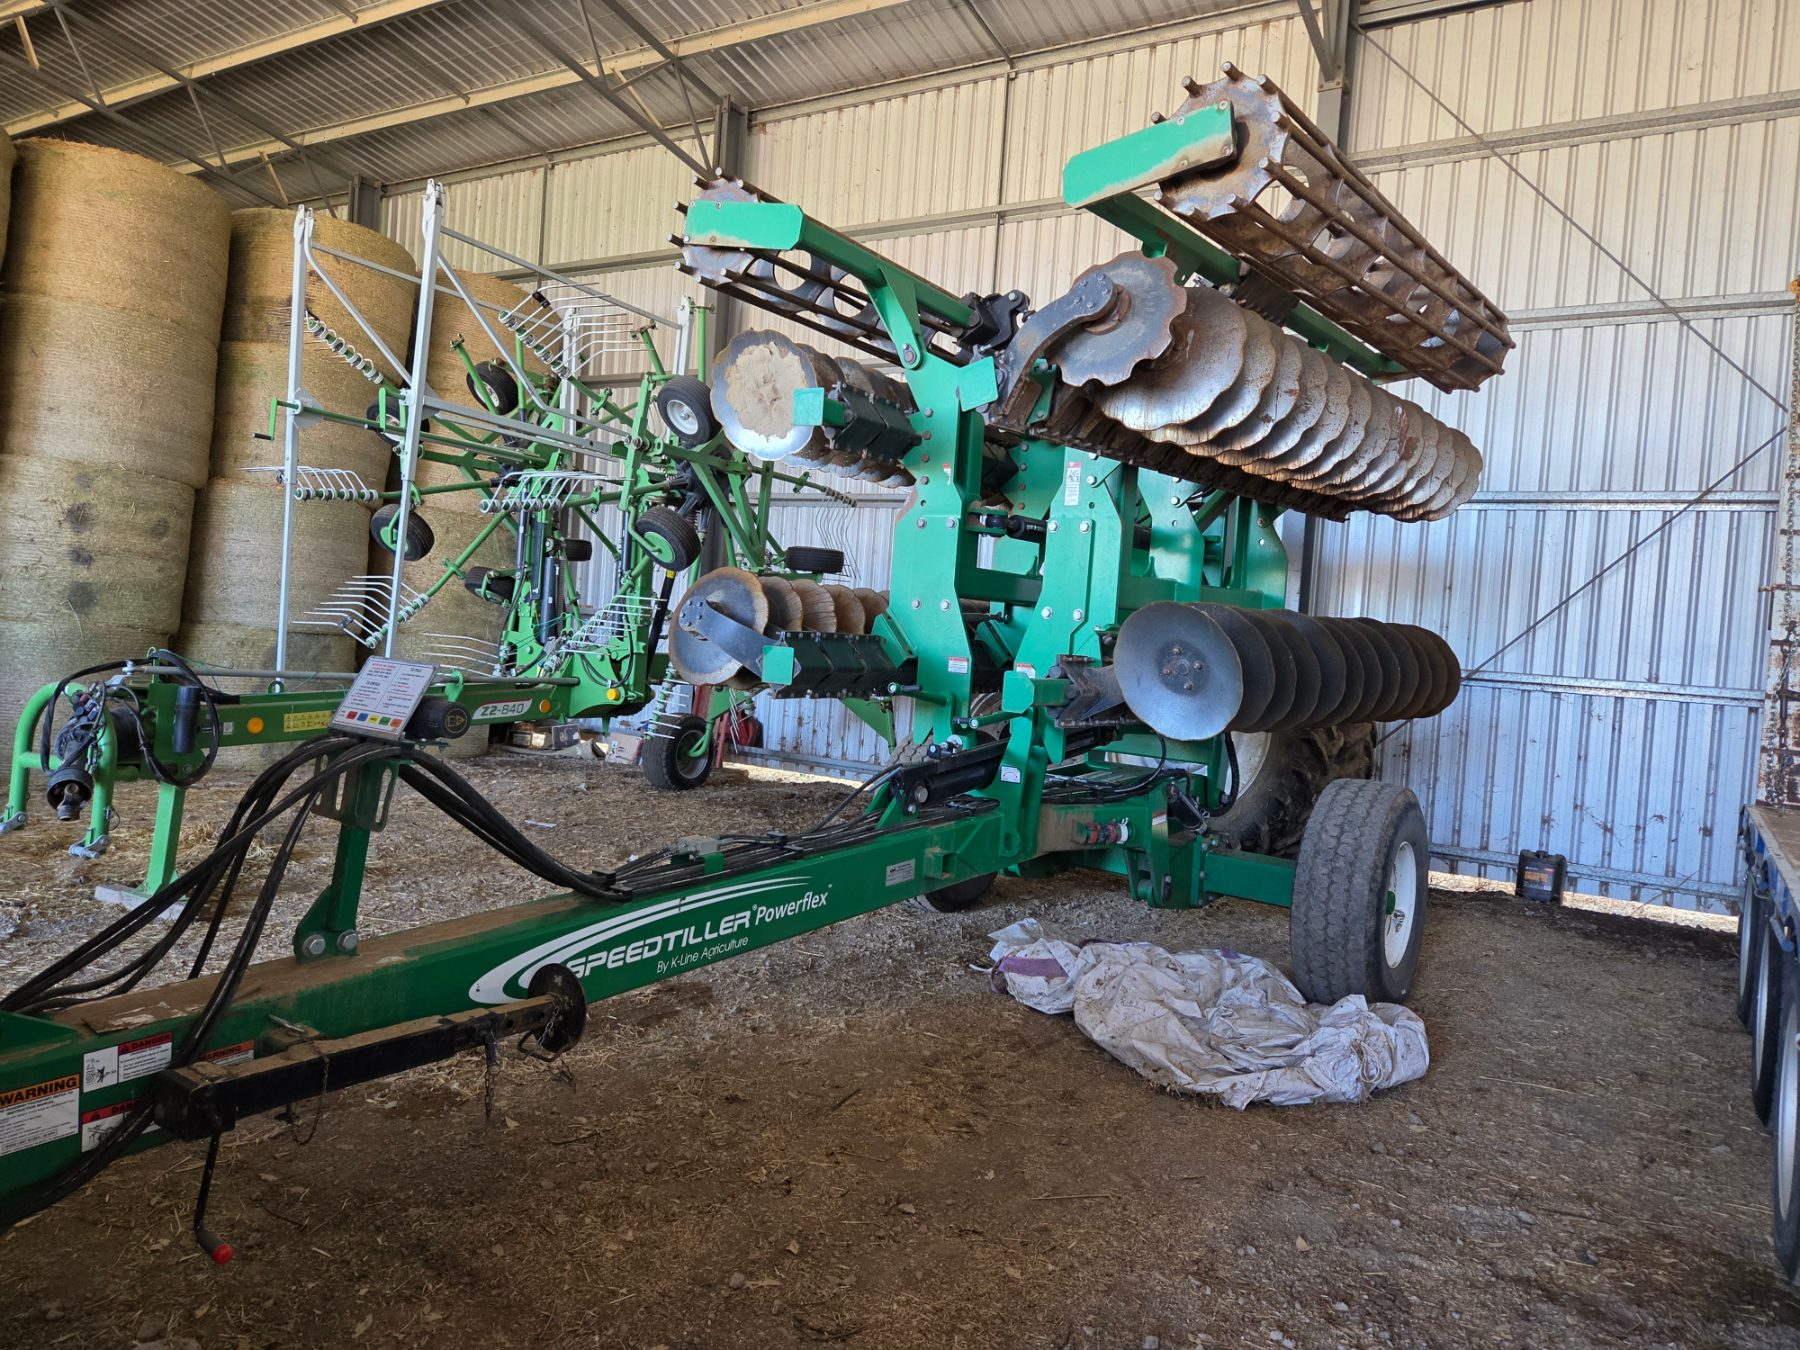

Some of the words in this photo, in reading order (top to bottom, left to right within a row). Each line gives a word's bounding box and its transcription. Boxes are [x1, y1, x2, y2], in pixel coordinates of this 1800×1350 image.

[566, 911, 751, 979] SPEEDTILLER
[755, 891, 828, 926] Powerflex
[656, 960, 670, 974] By
[671, 951, 699, 969] K-Line
[701, 937, 749, 960] Agriculture
[131, 1034, 171, 1049] DANGER
